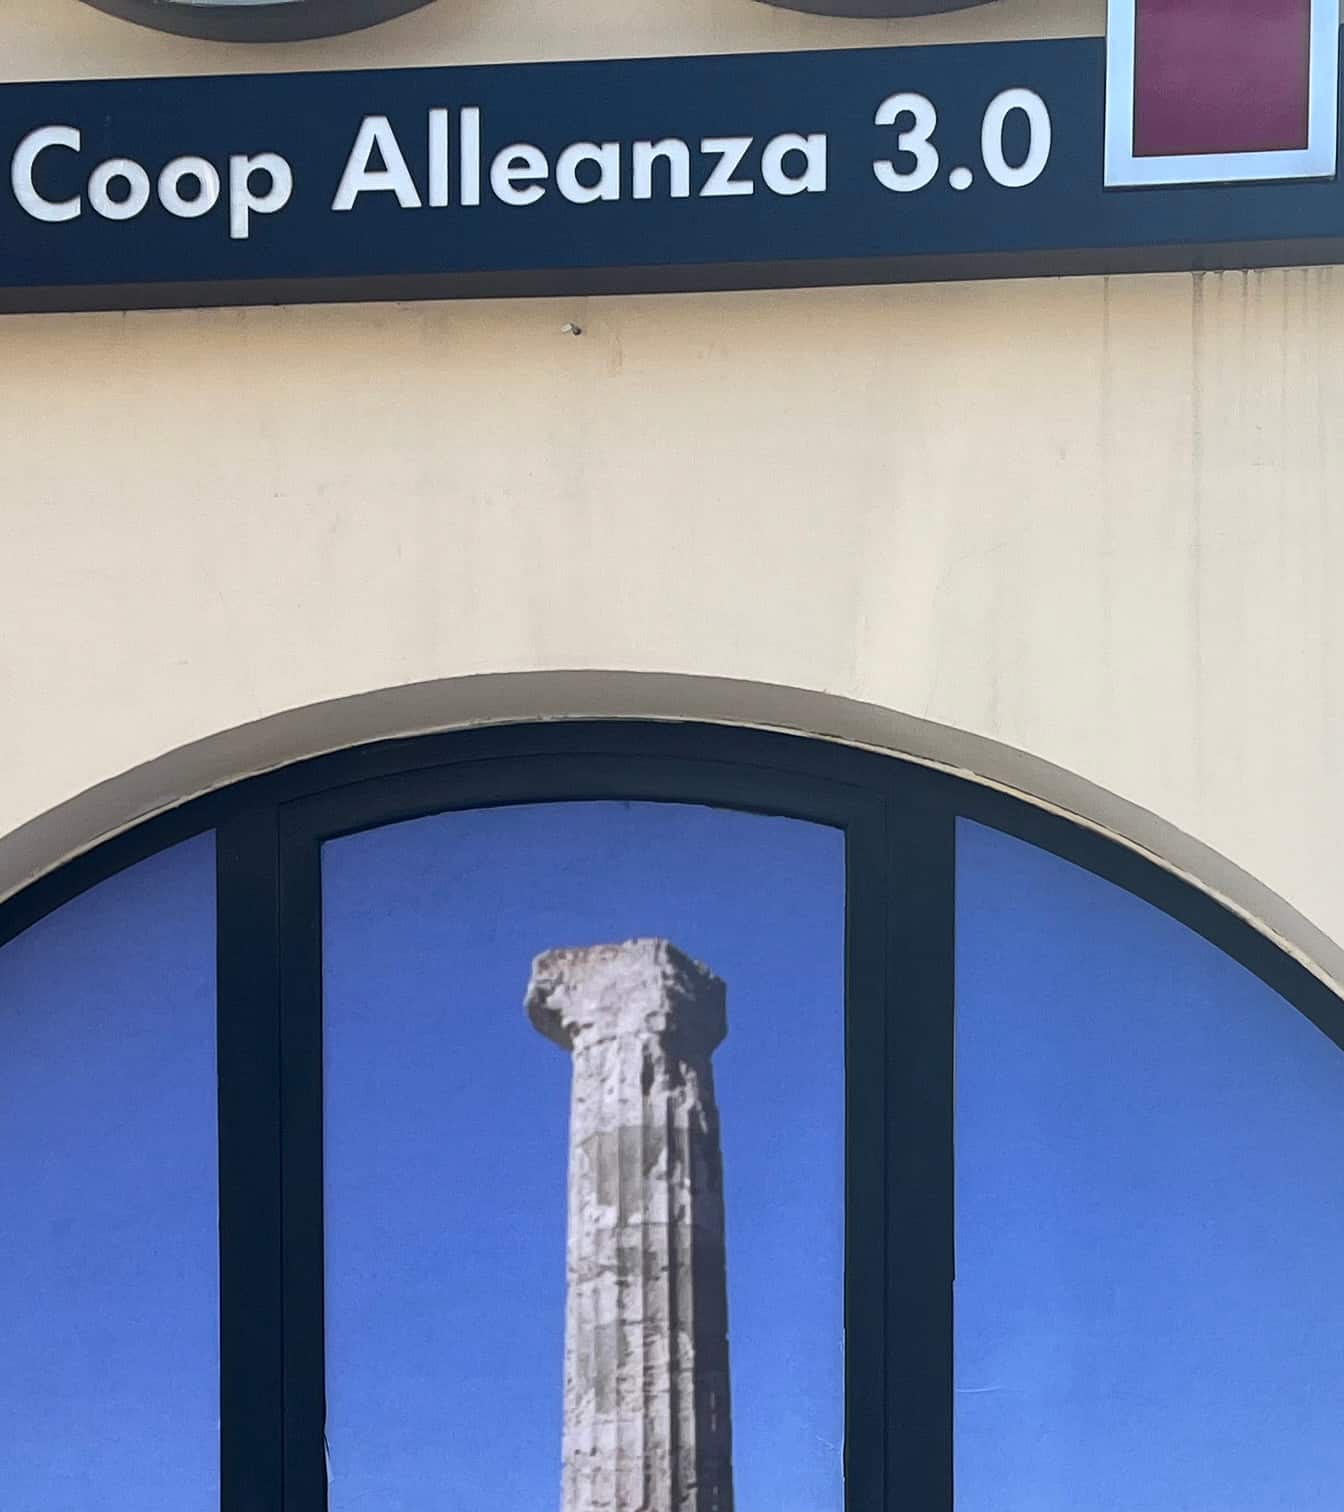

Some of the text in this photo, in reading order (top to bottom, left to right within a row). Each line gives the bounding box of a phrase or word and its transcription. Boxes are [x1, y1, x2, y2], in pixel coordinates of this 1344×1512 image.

[11, 125, 294, 240] Coop
[331, 106, 828, 212] Alleanza
[872, 87, 1052, 193] 3.0
